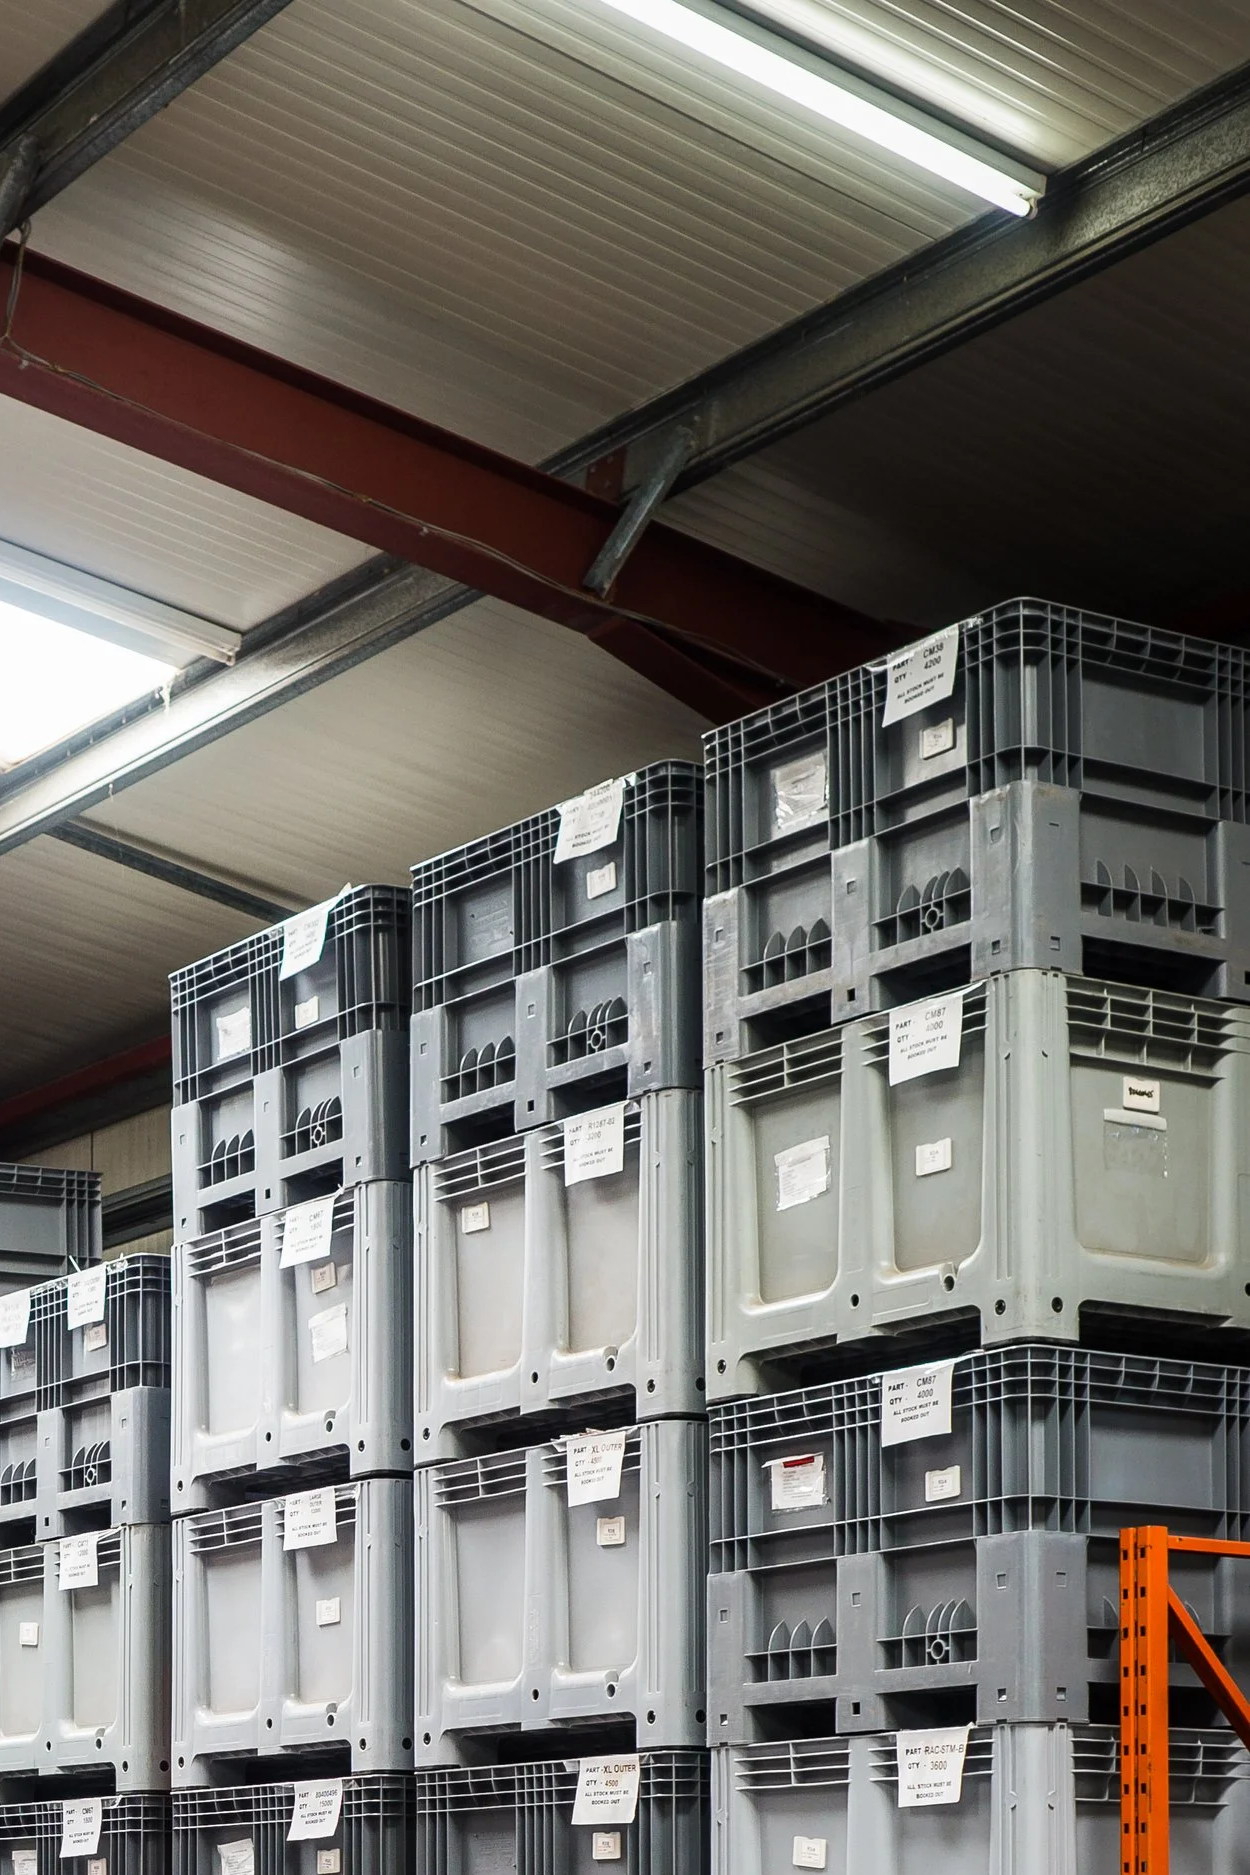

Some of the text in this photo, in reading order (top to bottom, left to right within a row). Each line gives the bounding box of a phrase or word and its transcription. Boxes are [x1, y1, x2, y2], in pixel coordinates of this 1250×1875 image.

[894, 673, 907, 684] QTY
[895, 1020, 911, 1030] PART
[897, 1034, 909, 1043] QTY
[888, 1375, 936, 1391] PART CM87
[889, 1388, 933, 1405] QTY 4000
[901, 1414, 919, 1423] BOOKED
[905, 1747, 921, 1756] PART
[614, 1764, 636, 1773] OUTER
[907, 1760, 948, 1771] QTY 3600
